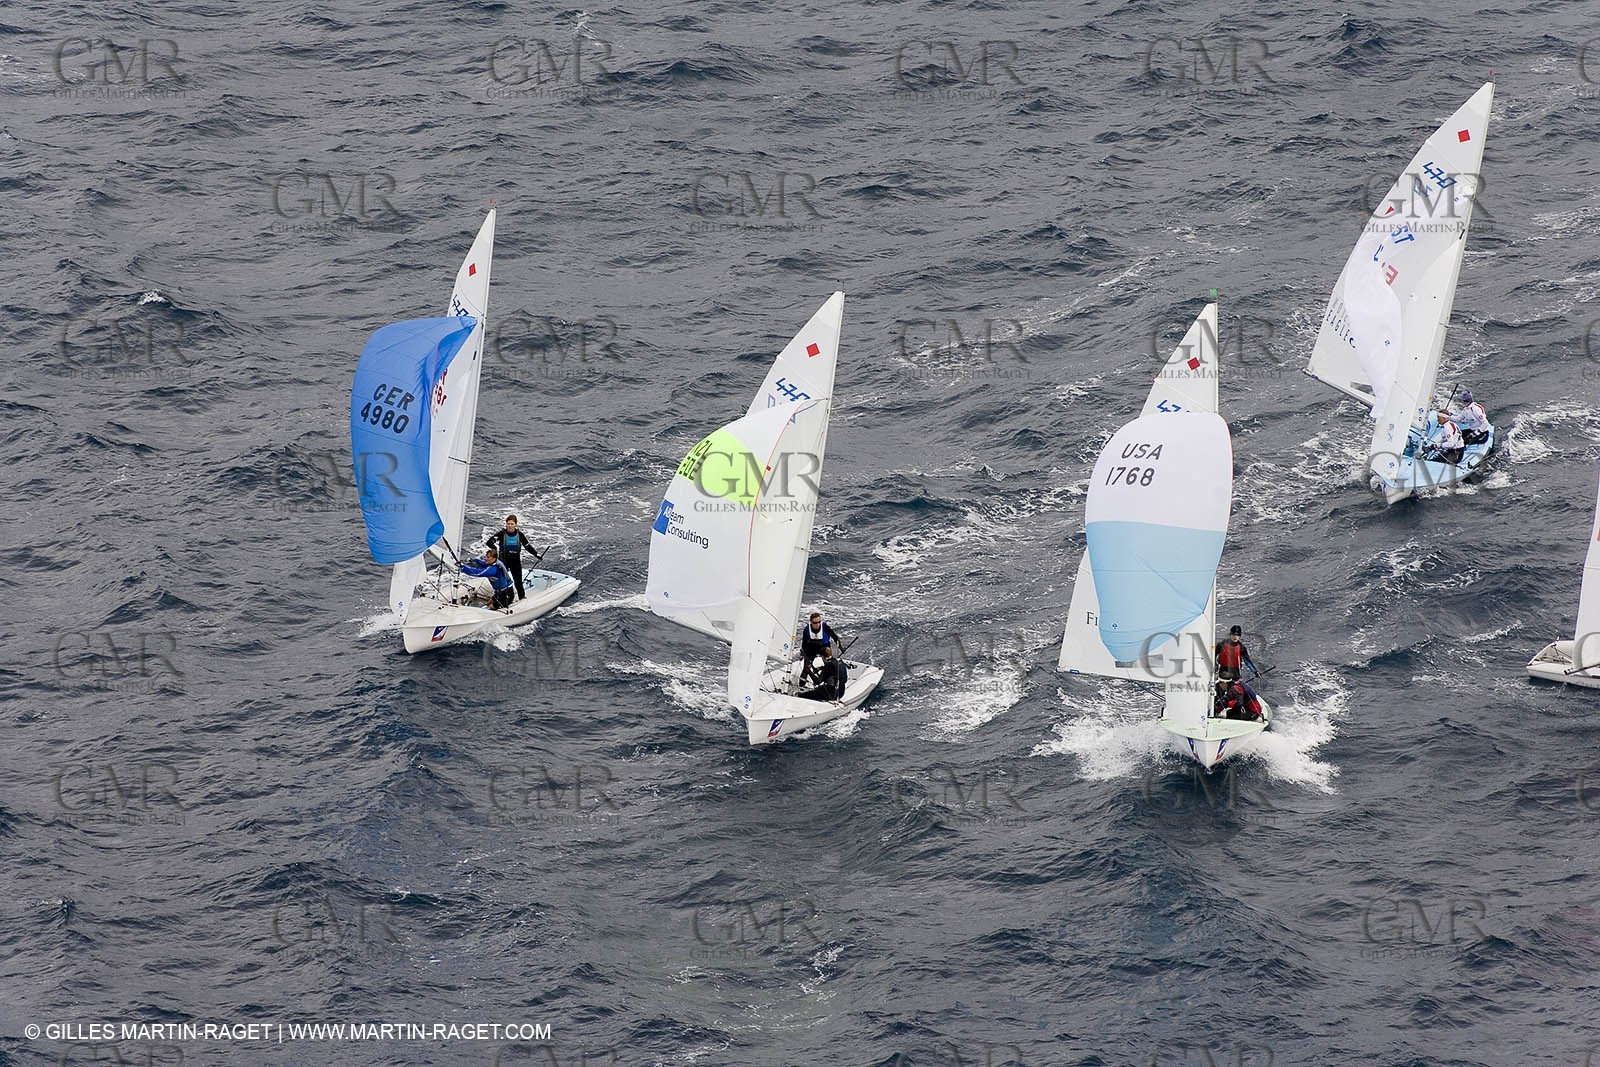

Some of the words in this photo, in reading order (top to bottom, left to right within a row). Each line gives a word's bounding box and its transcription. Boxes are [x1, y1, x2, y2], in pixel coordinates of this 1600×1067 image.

[373, 383, 416, 412] GER
[360, 402, 410, 434] 4980
[1121, 443, 1164, 461] USA
[1105, 466, 1155, 487] 1768
[667, 522, 710, 549] Consulting
